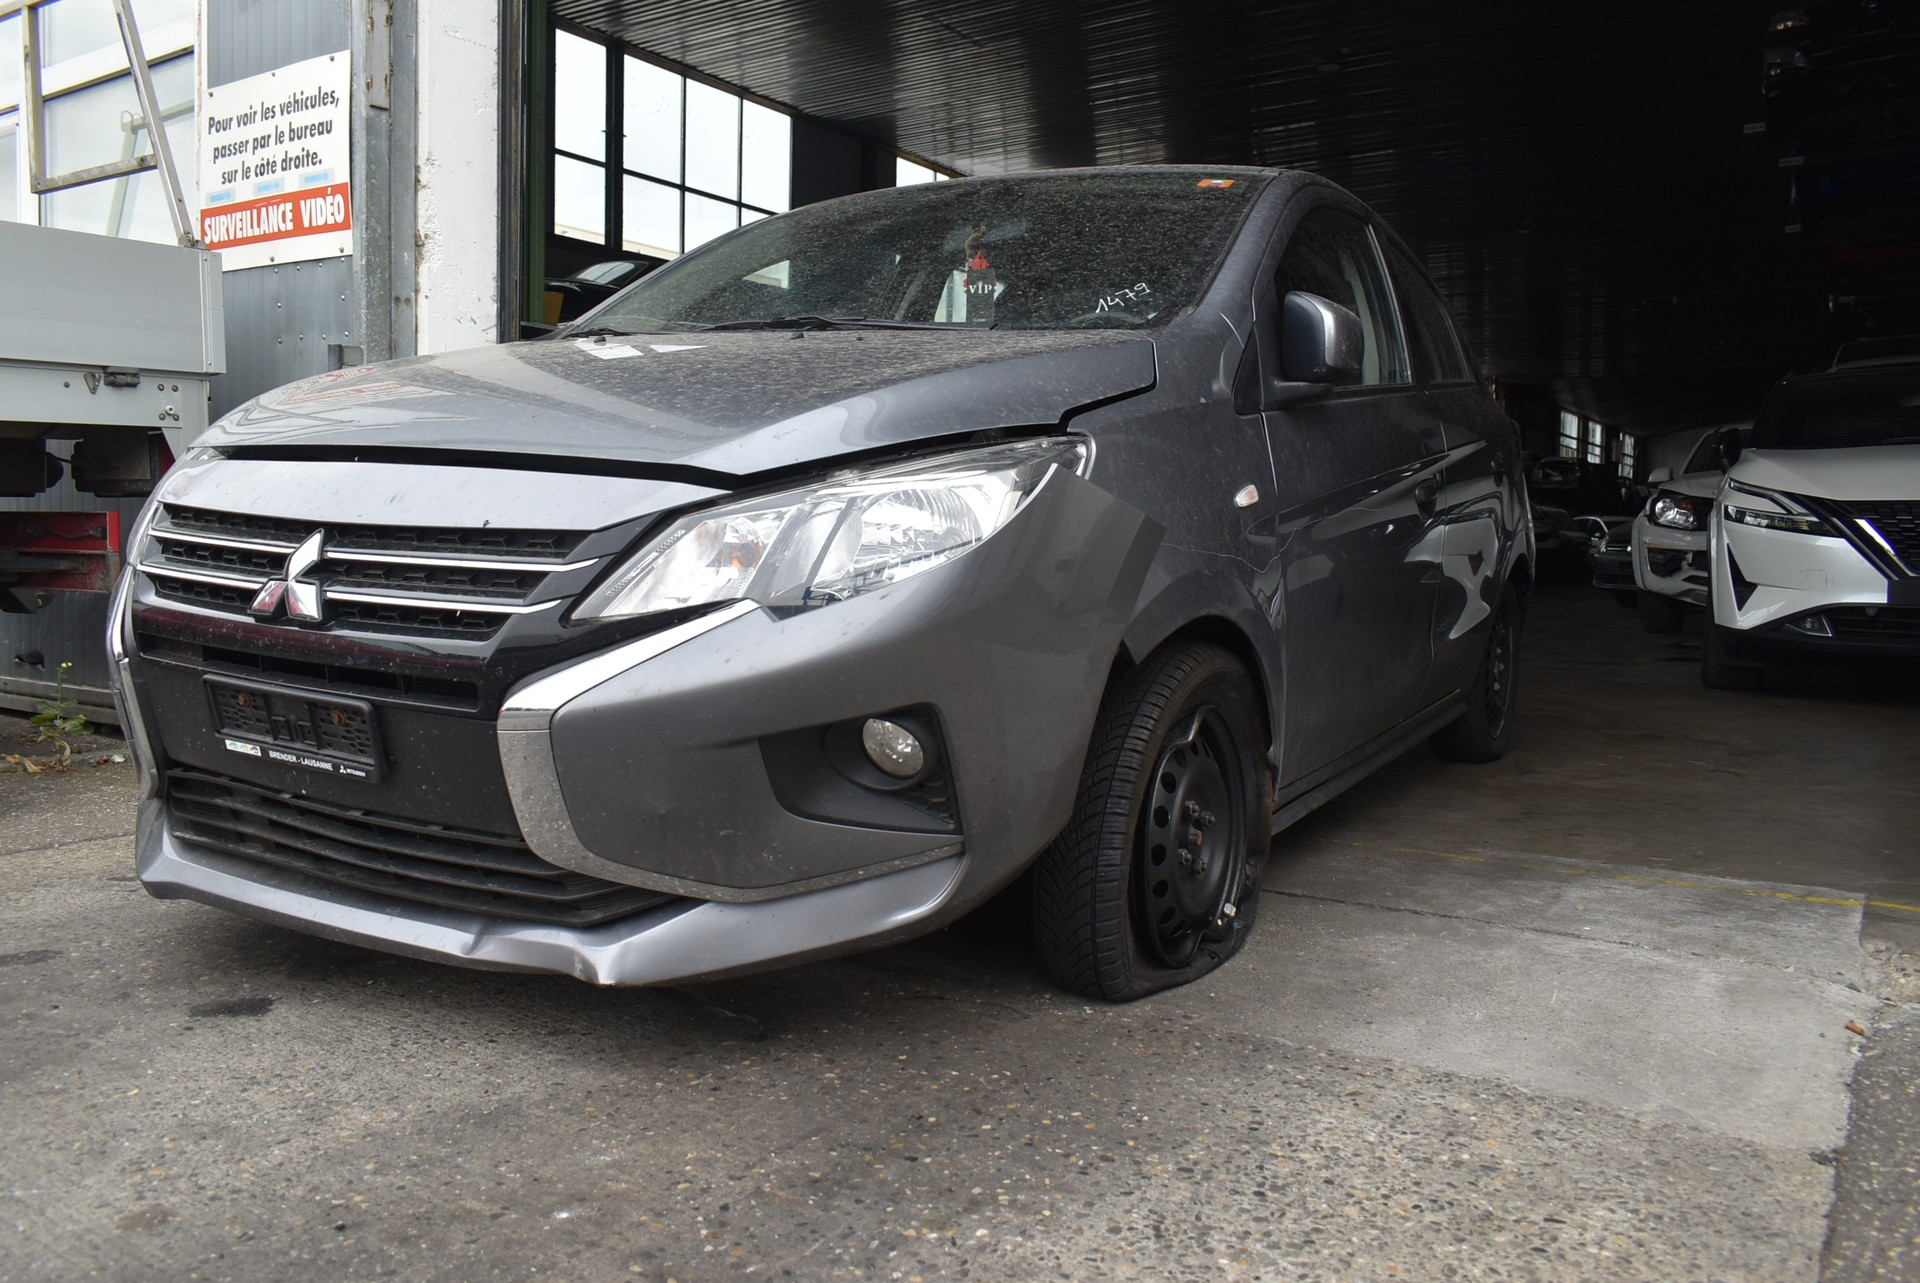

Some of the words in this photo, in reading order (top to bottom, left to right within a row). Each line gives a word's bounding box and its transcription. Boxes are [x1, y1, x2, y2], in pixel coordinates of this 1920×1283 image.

[208, 116, 233, 135] Pour
[236, 105, 258, 128] voir
[260, 101, 276, 122] les
[279, 86, 340, 116] véhicules,
[213, 141, 249, 164] passer
[252, 133, 271, 155] par
[275, 125, 285, 146] le
[289, 119, 333, 142] bureau
[221, 170, 237, 185] sur
[241, 161, 251, 181] le
[254, 154, 277, 178] côté
[281, 147, 322, 172] droite.
[204, 201, 294, 245] SURVEILLANCE
[300, 187, 345, 228] VIDÉO
[969, 284, 993, 294] VIP
[1096, 282, 1150, 313] 1479
[268, 750, 297, 763] BRENDER
[300, 757, 333, 771] LAUSANNE
